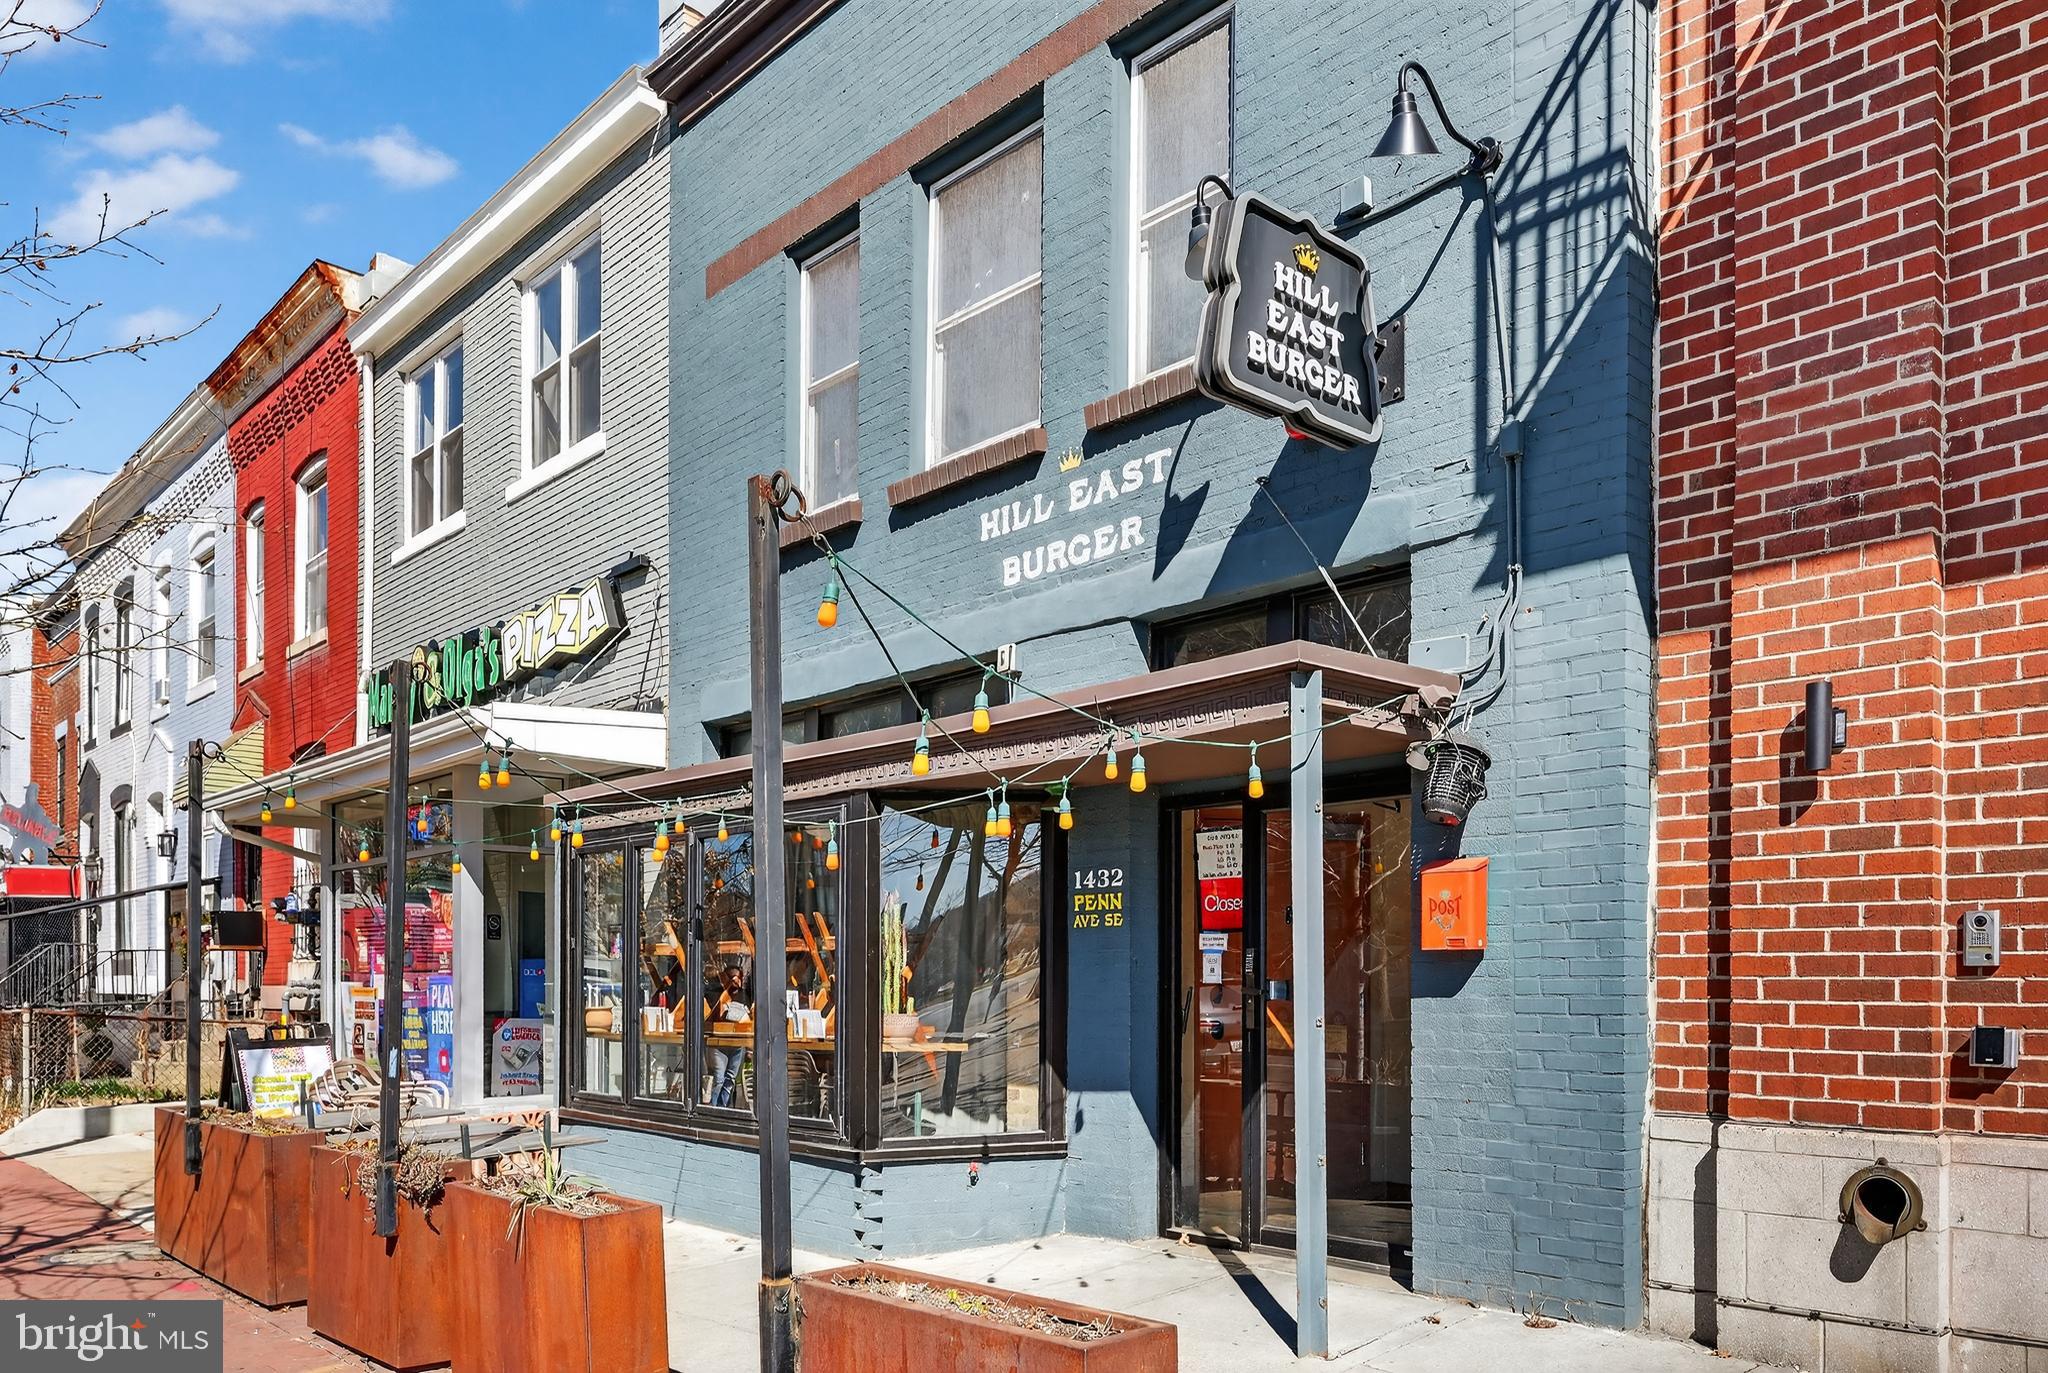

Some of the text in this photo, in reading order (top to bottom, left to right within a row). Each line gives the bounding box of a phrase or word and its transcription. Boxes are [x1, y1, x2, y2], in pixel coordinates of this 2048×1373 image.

[1273, 261, 1340, 318] HILL
[1266, 298, 1345, 358] EAST
[1247, 329, 1362, 406] BURGER
[979, 447, 1173, 542] HILL EAST
[1002, 515, 1146, 587] BURGER
[443, 625, 500, 707] Olga's
[502, 580, 609, 678] PIZZA
[1074, 868, 1123, 889] 1432
[1074, 893, 1122, 911] PENN
[1204, 895, 1243, 912] Close
[1073, 913, 1123, 928] AVE SE
[1429, 895, 1462, 921] POST
